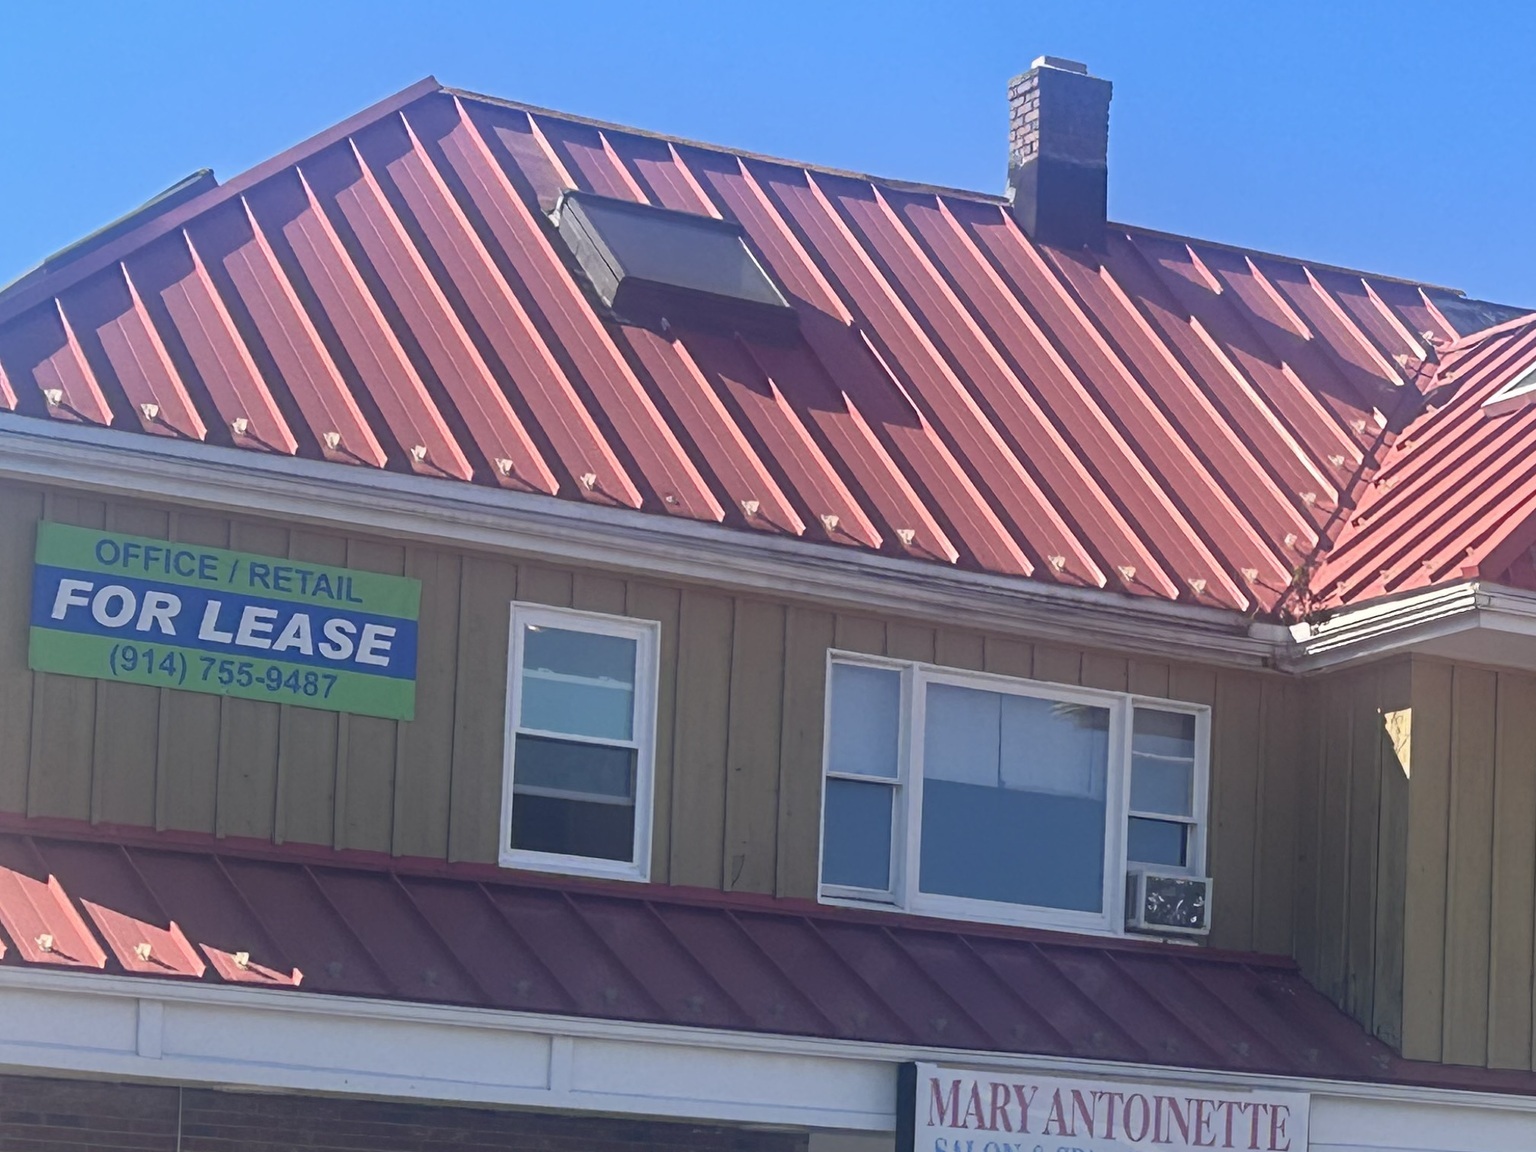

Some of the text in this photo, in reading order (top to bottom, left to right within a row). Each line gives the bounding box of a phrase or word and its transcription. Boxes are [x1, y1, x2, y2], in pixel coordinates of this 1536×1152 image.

[95, 538, 364, 604] OFFICE / RETAIL
[51, 578, 397, 667] FOR LEASE
[108, 643, 338, 700] (914) 755-9487
[927, 1077, 1292, 1152] MARY ANTOINETTE
